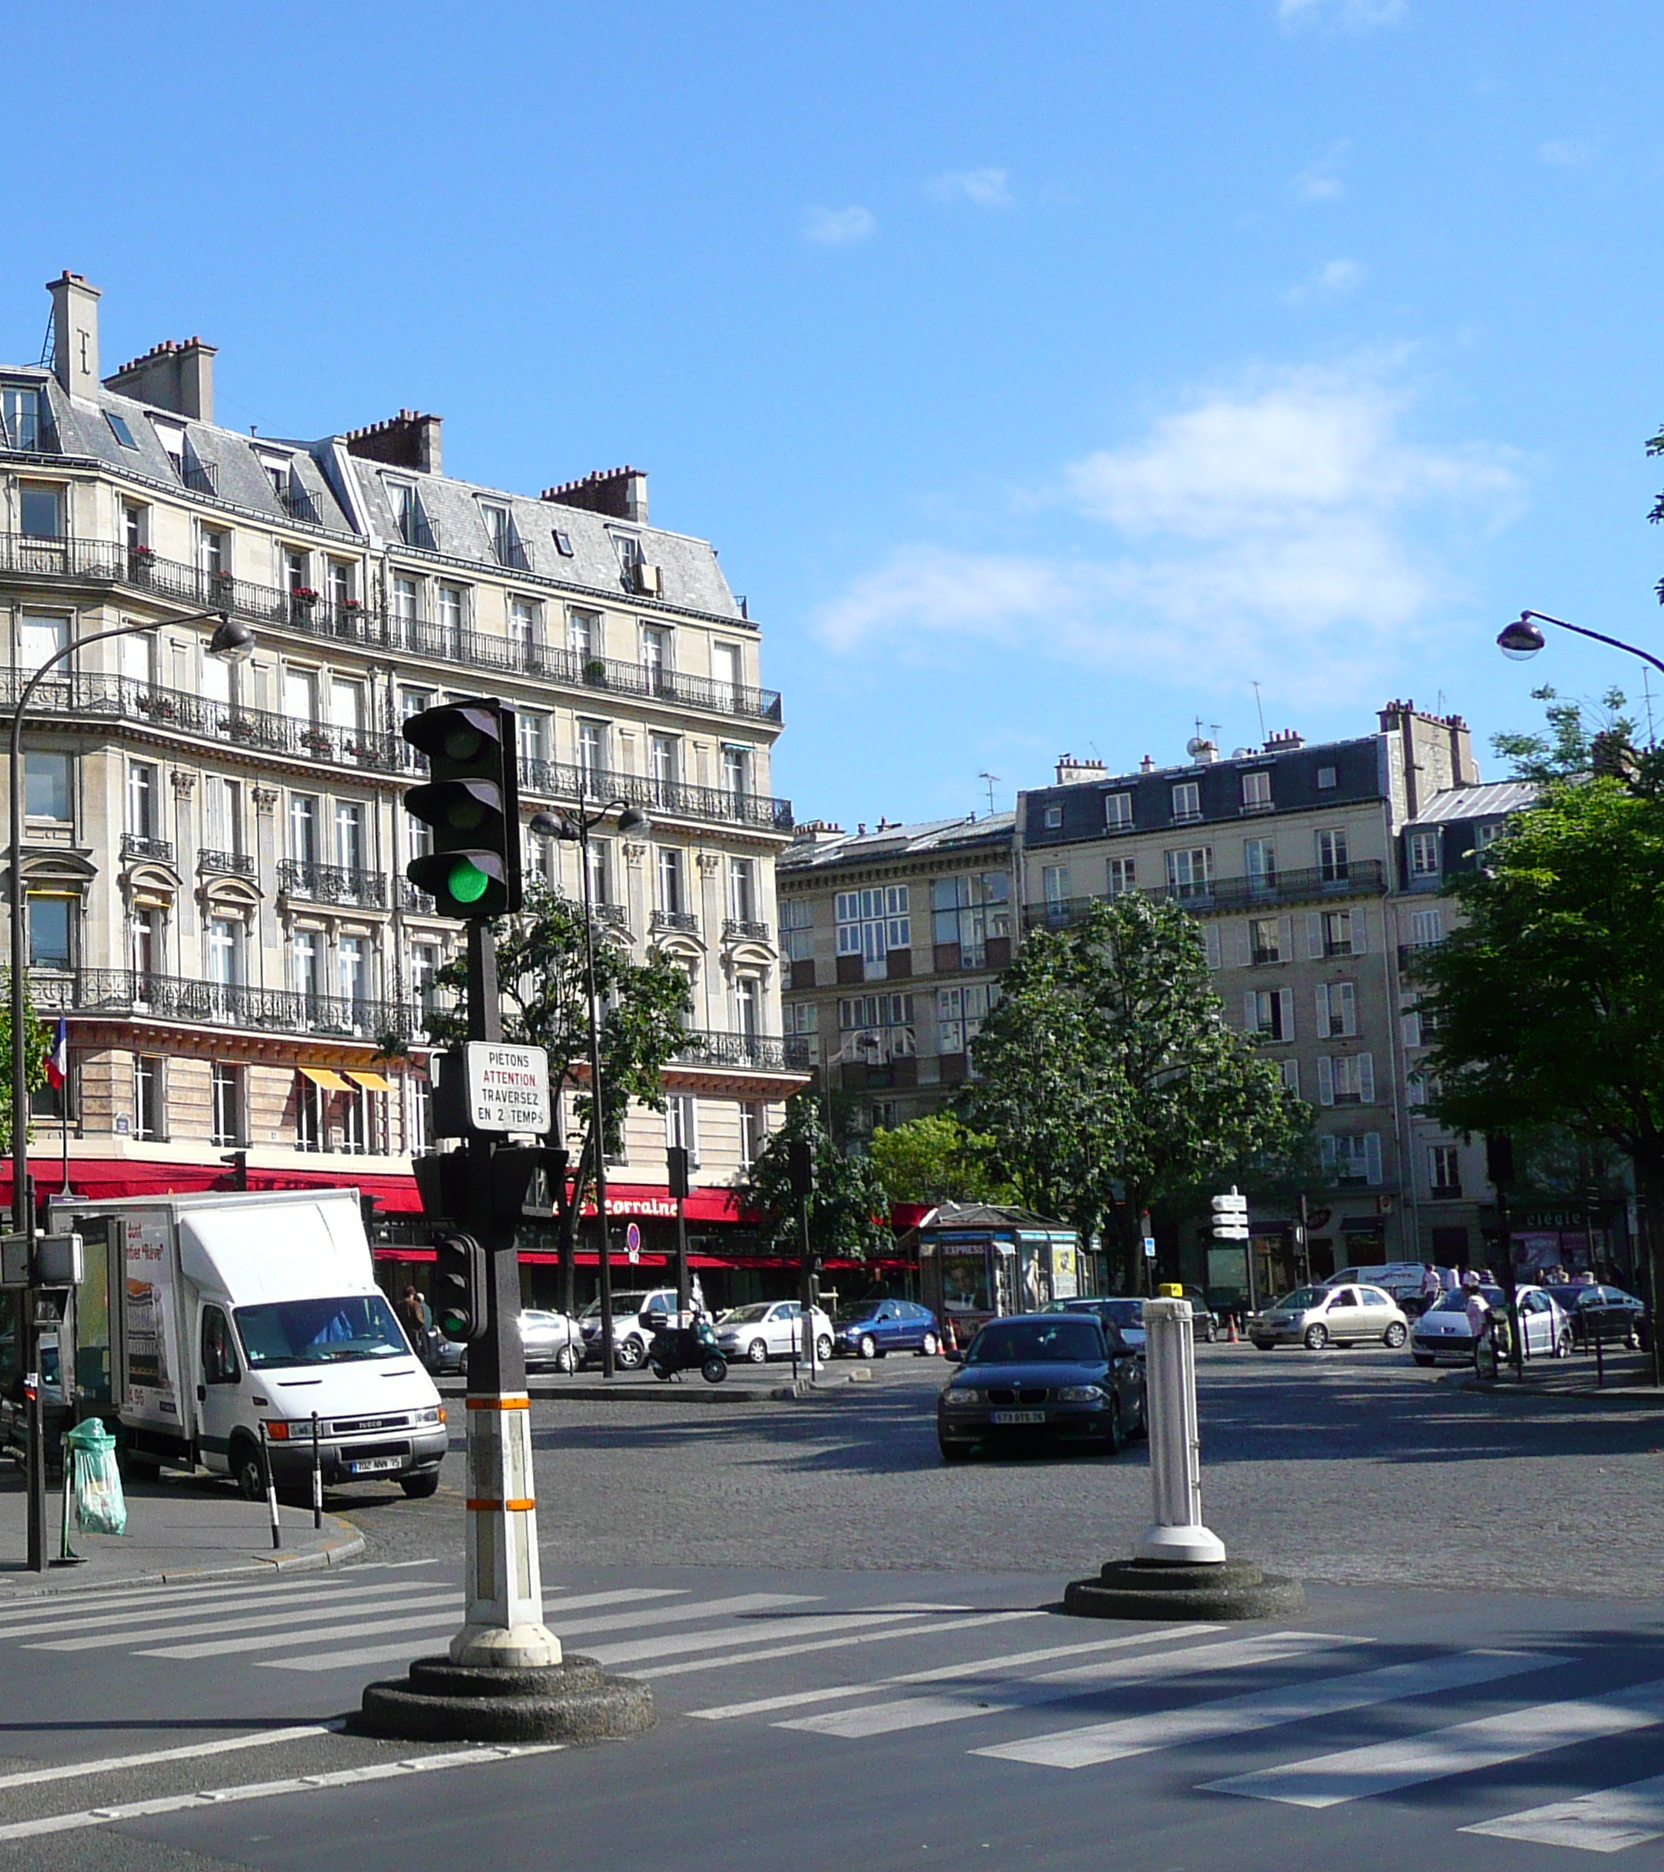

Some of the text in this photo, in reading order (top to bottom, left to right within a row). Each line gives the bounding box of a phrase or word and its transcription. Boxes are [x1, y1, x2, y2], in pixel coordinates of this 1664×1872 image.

[483, 1070, 536, 1087] ATTENTION
[482, 1089, 539, 1105] TRAVERSEZ
[478, 1107, 544, 1124] EN 2 TEMPS
